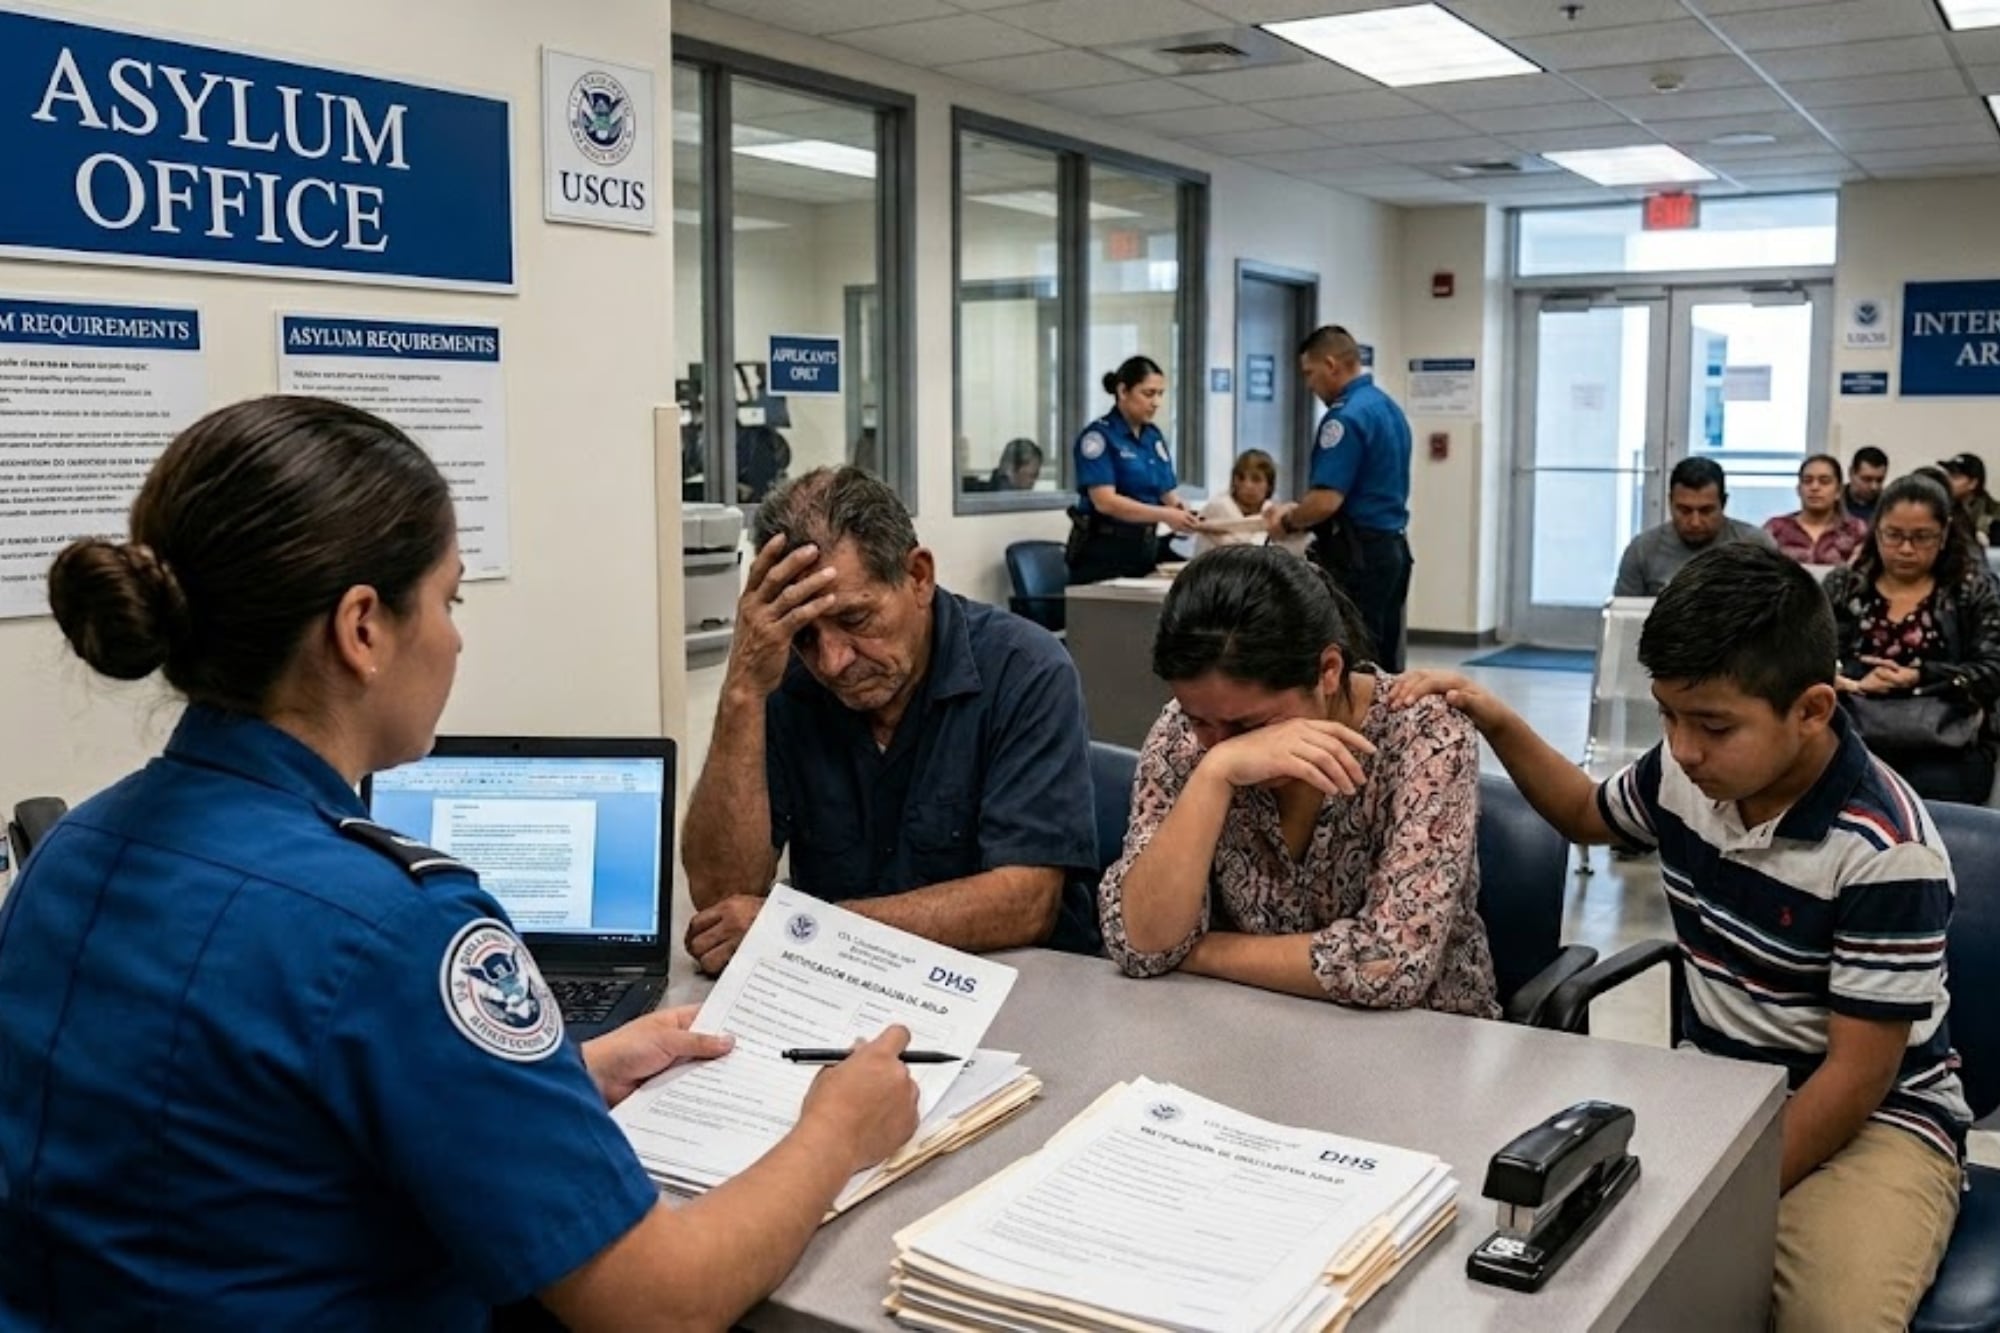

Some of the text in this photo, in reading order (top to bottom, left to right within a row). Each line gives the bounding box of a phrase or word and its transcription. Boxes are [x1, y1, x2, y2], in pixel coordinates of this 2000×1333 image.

[32, 47, 411, 171] ASYLUM
[75, 153, 389, 253] OFFICE
[559, 170, 646, 210] USCIS
[22, 313, 191, 341] REQUIREMENTS
[288, 327, 496, 353] ASYLUM REQUIREMENTS
